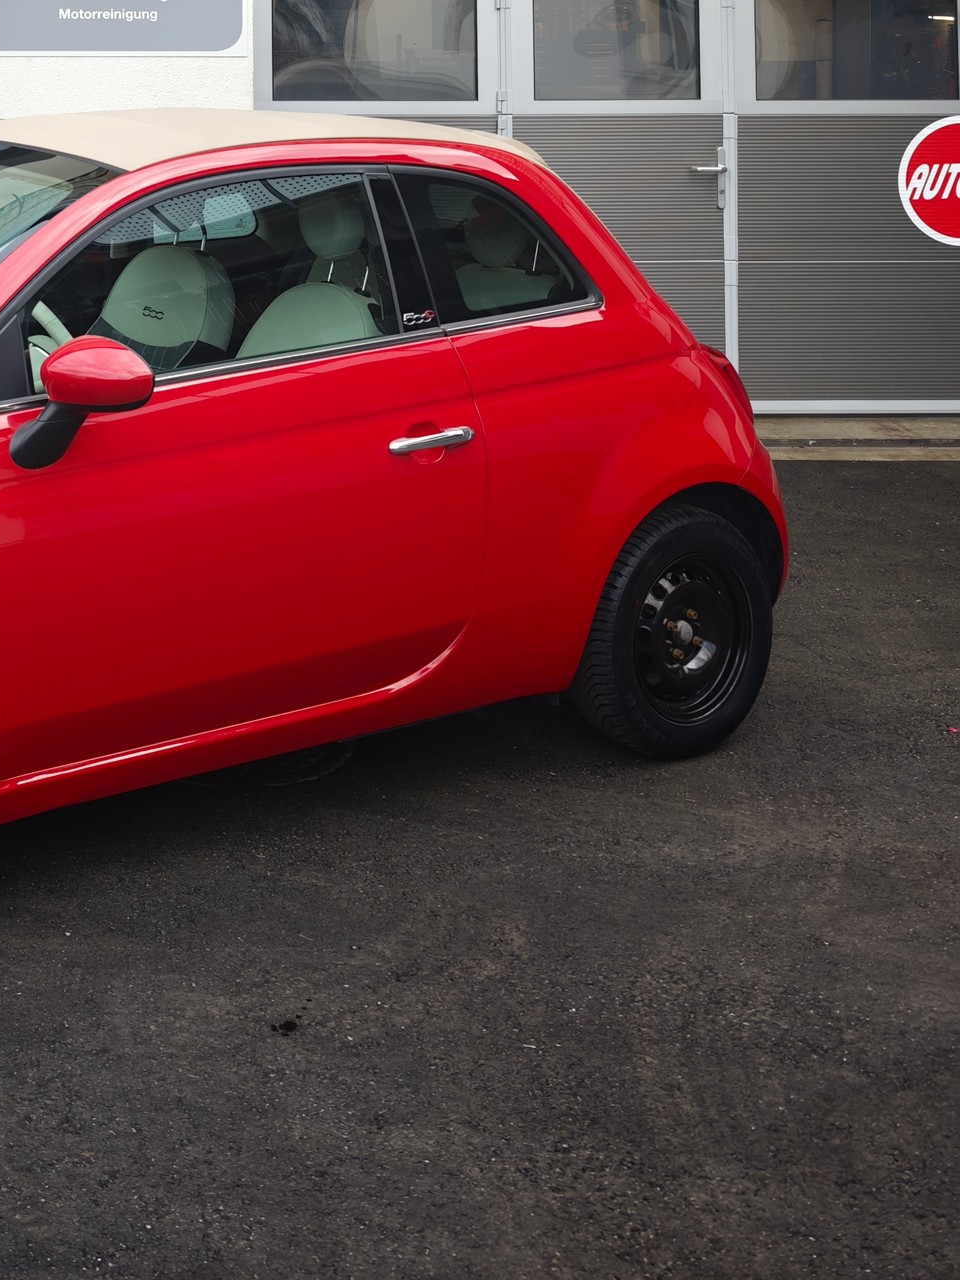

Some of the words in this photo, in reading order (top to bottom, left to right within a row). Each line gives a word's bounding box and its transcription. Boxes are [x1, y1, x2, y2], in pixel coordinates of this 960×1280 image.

[58, 8, 158, 22] Motorreinigung
[906, 163, 960, 201] AUT
[142, 305, 165, 320] 500
